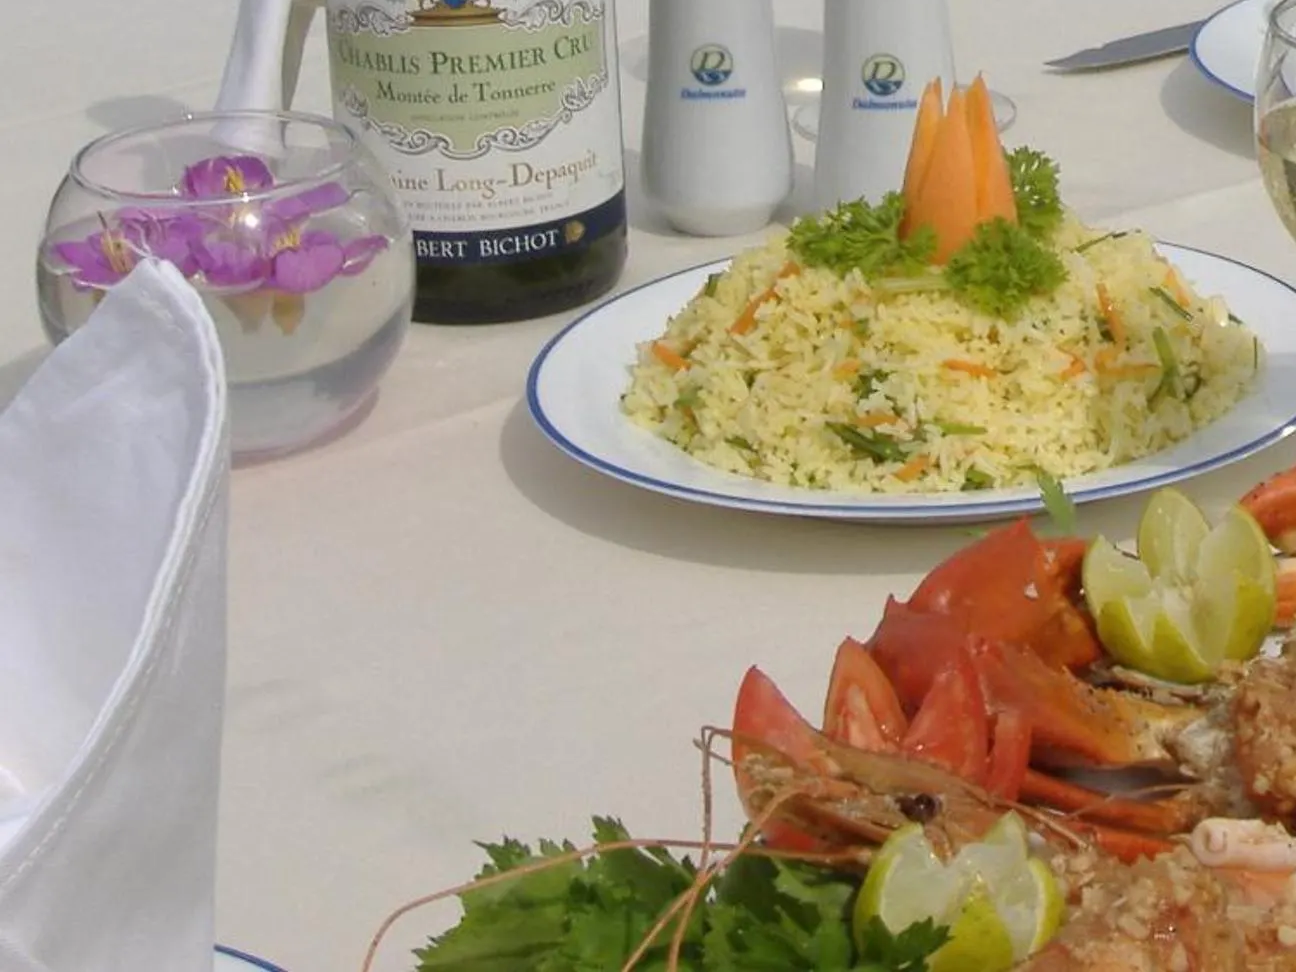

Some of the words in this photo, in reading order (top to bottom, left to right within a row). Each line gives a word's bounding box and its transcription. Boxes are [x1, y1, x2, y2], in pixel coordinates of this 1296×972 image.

[338, 40, 421, 75] CHABLIS
[429, 46, 547, 75] PREMIER
[553, 31, 594, 60] CRU
[376, 80, 442, 104] Montée
[448, 82, 469, 104] de
[472, 80, 557, 102] Tonnerre
[416, 238, 468, 259] BERT
[479, 228, 560, 258] BICHOT
